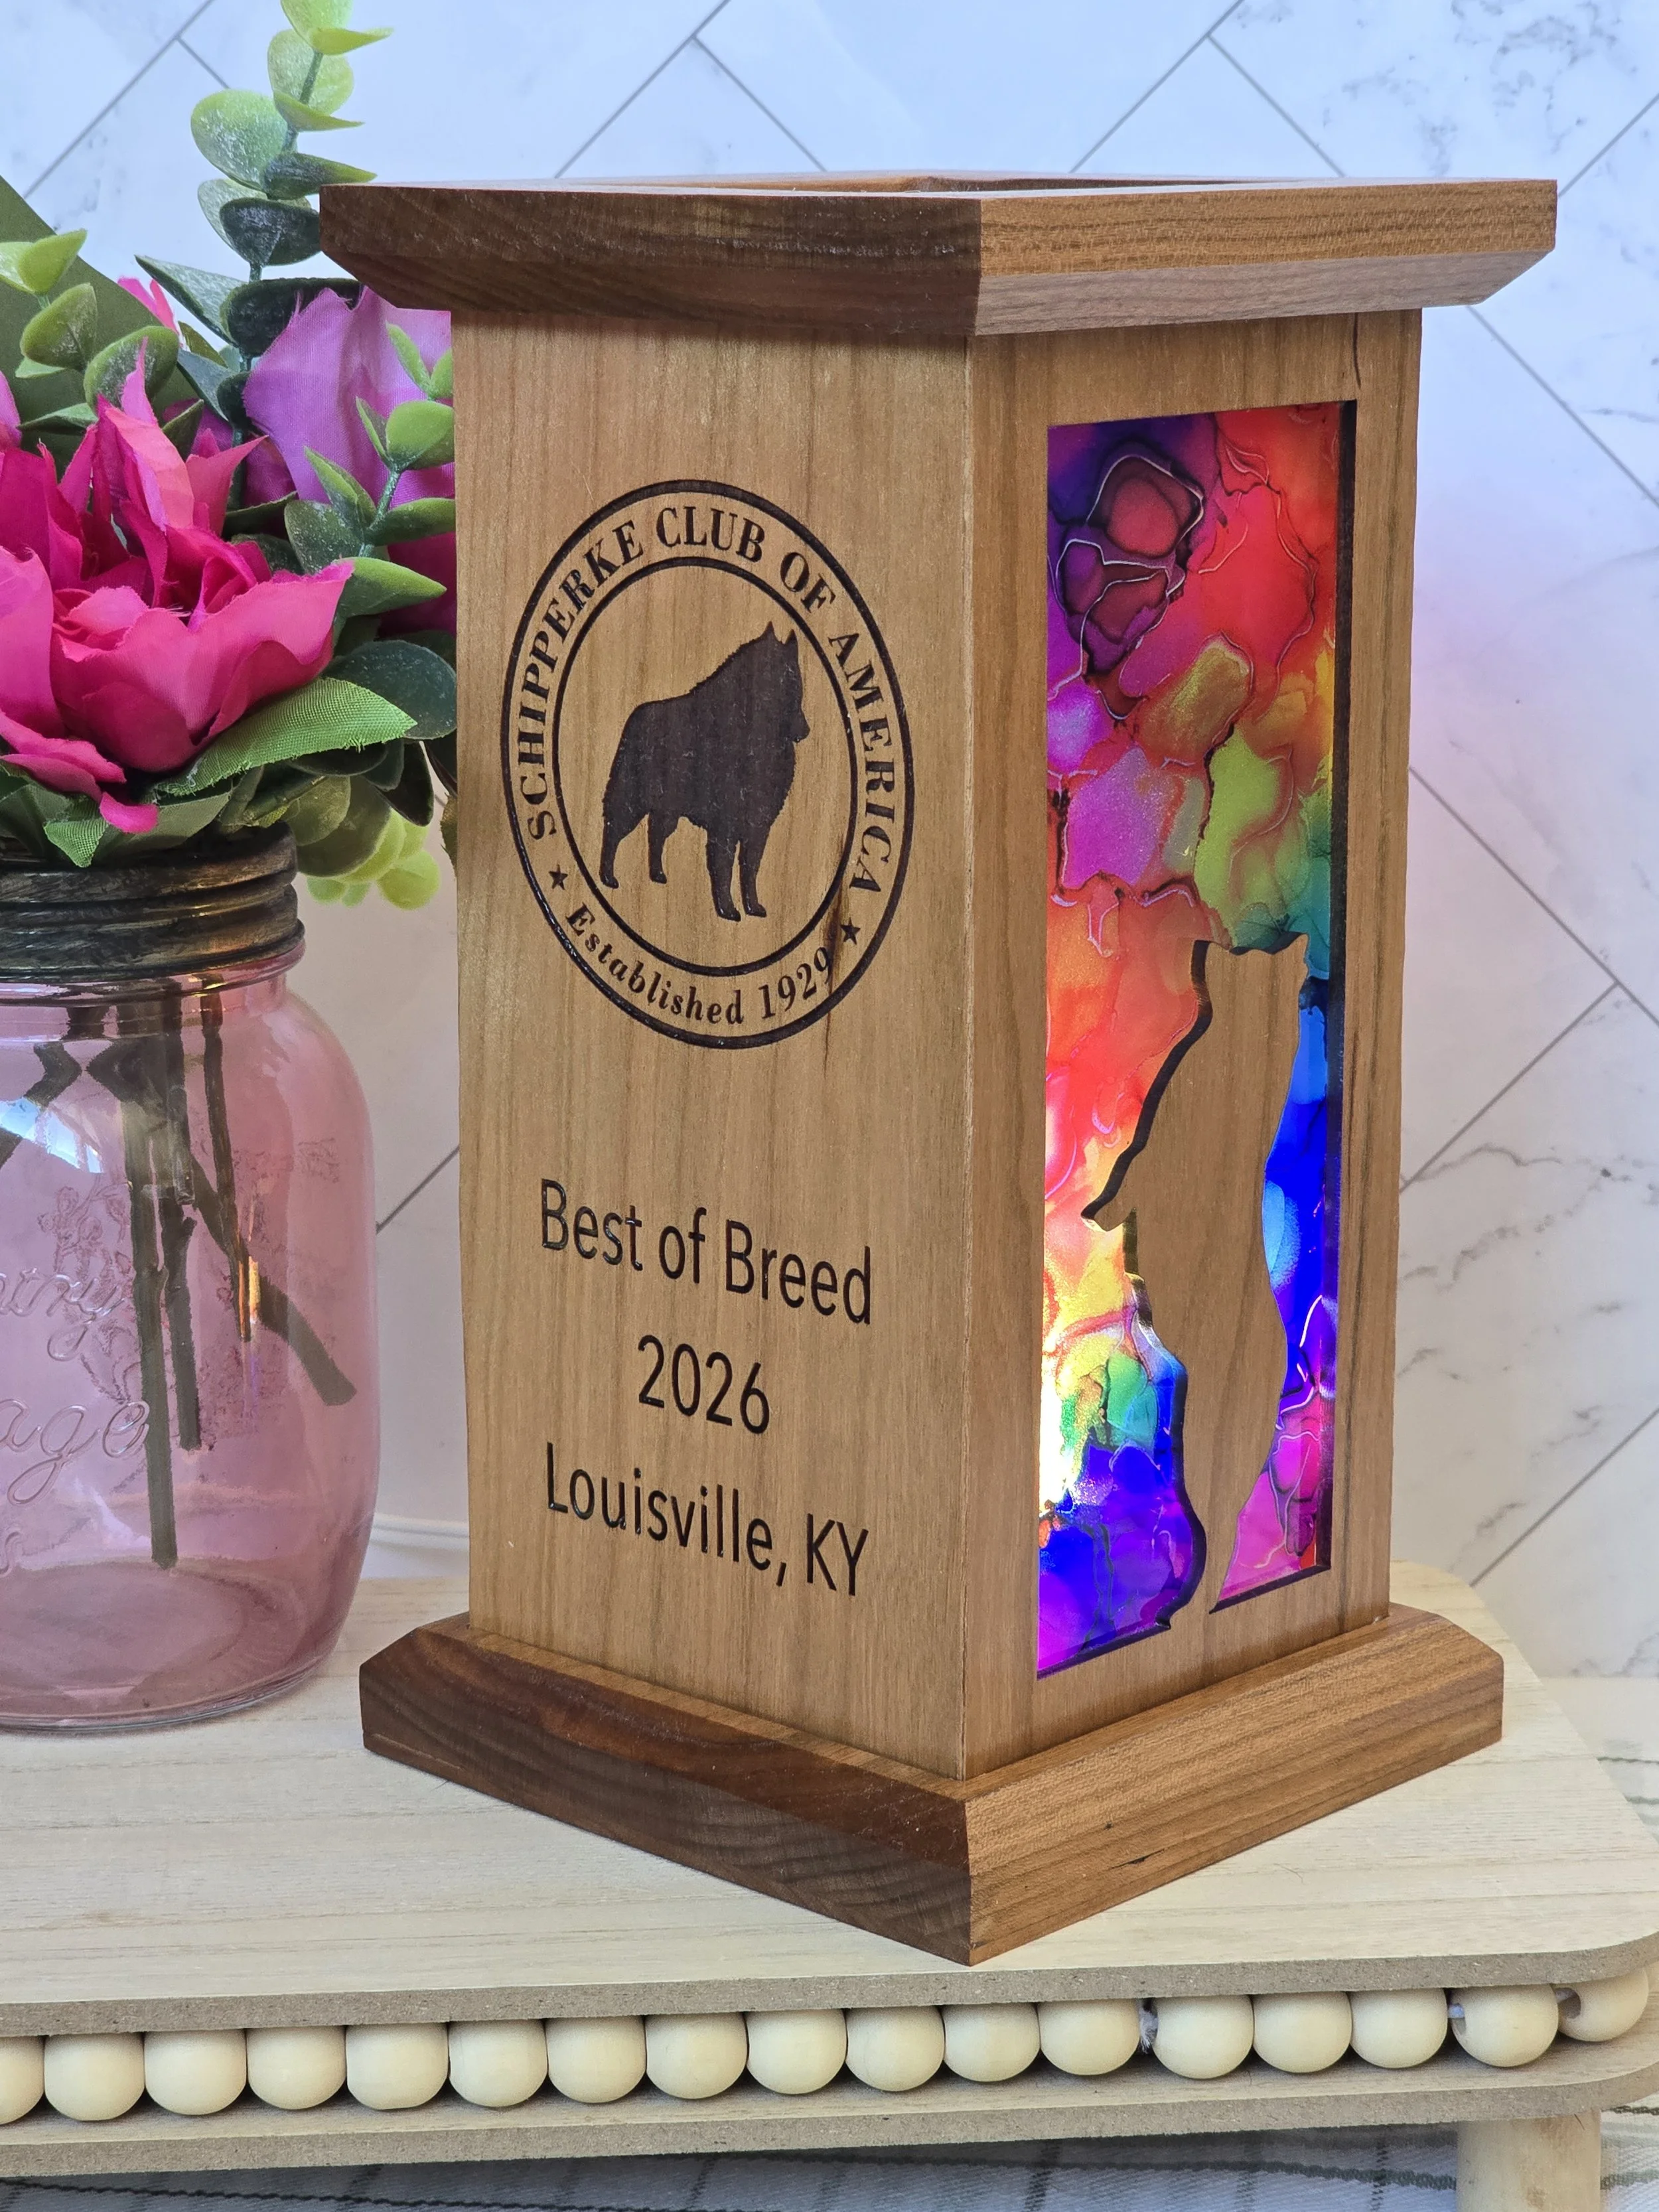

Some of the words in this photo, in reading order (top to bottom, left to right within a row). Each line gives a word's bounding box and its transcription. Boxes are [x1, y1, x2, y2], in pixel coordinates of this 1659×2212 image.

[517, 520, 644, 840] SCHIPPERKE
[655, 506, 766, 563] CLUB
[780, 552, 836, 613] OF
[828, 632, 895, 892] AMERICA
[565, 903, 745, 1024] Established
[759, 945, 831, 1019] 1929
[540, 1178, 644, 1272] Best
[658, 1207, 707, 1284] of
[725, 1218, 871, 1325] Breed
[637, 1334, 770, 1435] 2026
[547, 1441, 787, 1587] Louisville,
[806, 1512, 869, 1597] KY
